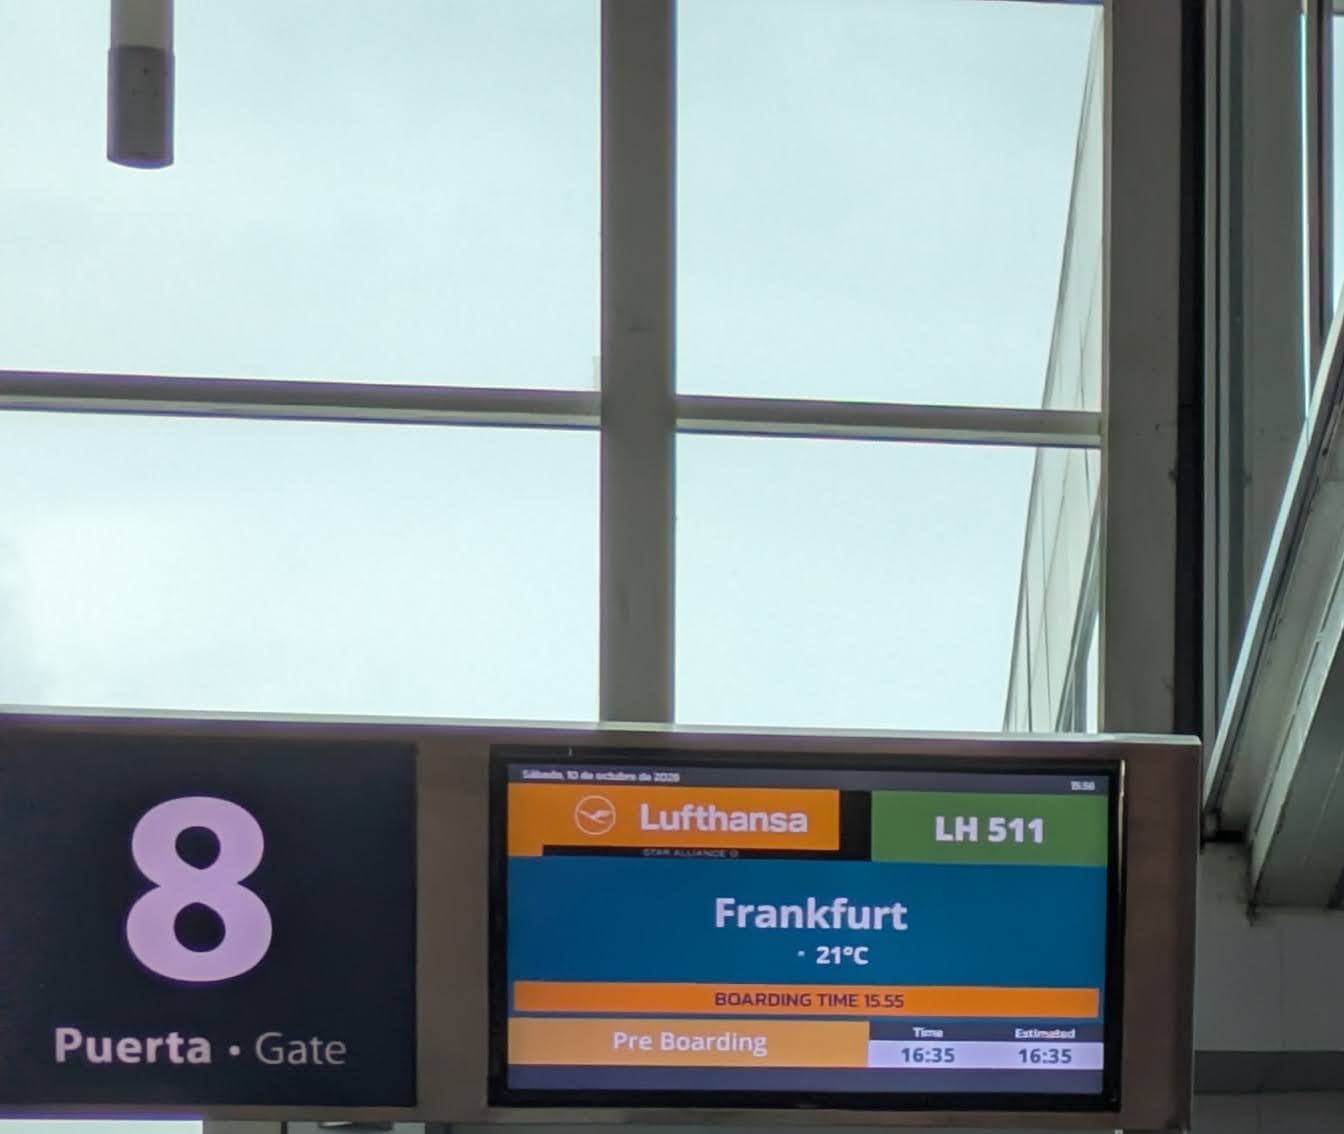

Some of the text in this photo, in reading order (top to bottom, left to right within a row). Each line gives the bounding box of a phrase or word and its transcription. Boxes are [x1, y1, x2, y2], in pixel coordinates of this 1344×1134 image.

[640, 802, 808, 835] Lufthansa
[935, 816, 1045, 845] LH 511
[125, 795, 273, 983] 8
[714, 896, 909, 932] Frankfurt
[816, 944, 869, 966] 21°C
[714, 990, 905, 1010] BOARDING TIME 15.55
[54, 1026, 348, 1066] Puerta Gate
[613, 1030, 768, 1057] Pre Boarding
[912, 1027, 1077, 1040] Time Estimated
[901, 1047, 956, 1065] 16:35
[1018, 1047, 1073, 1065] 16:35
